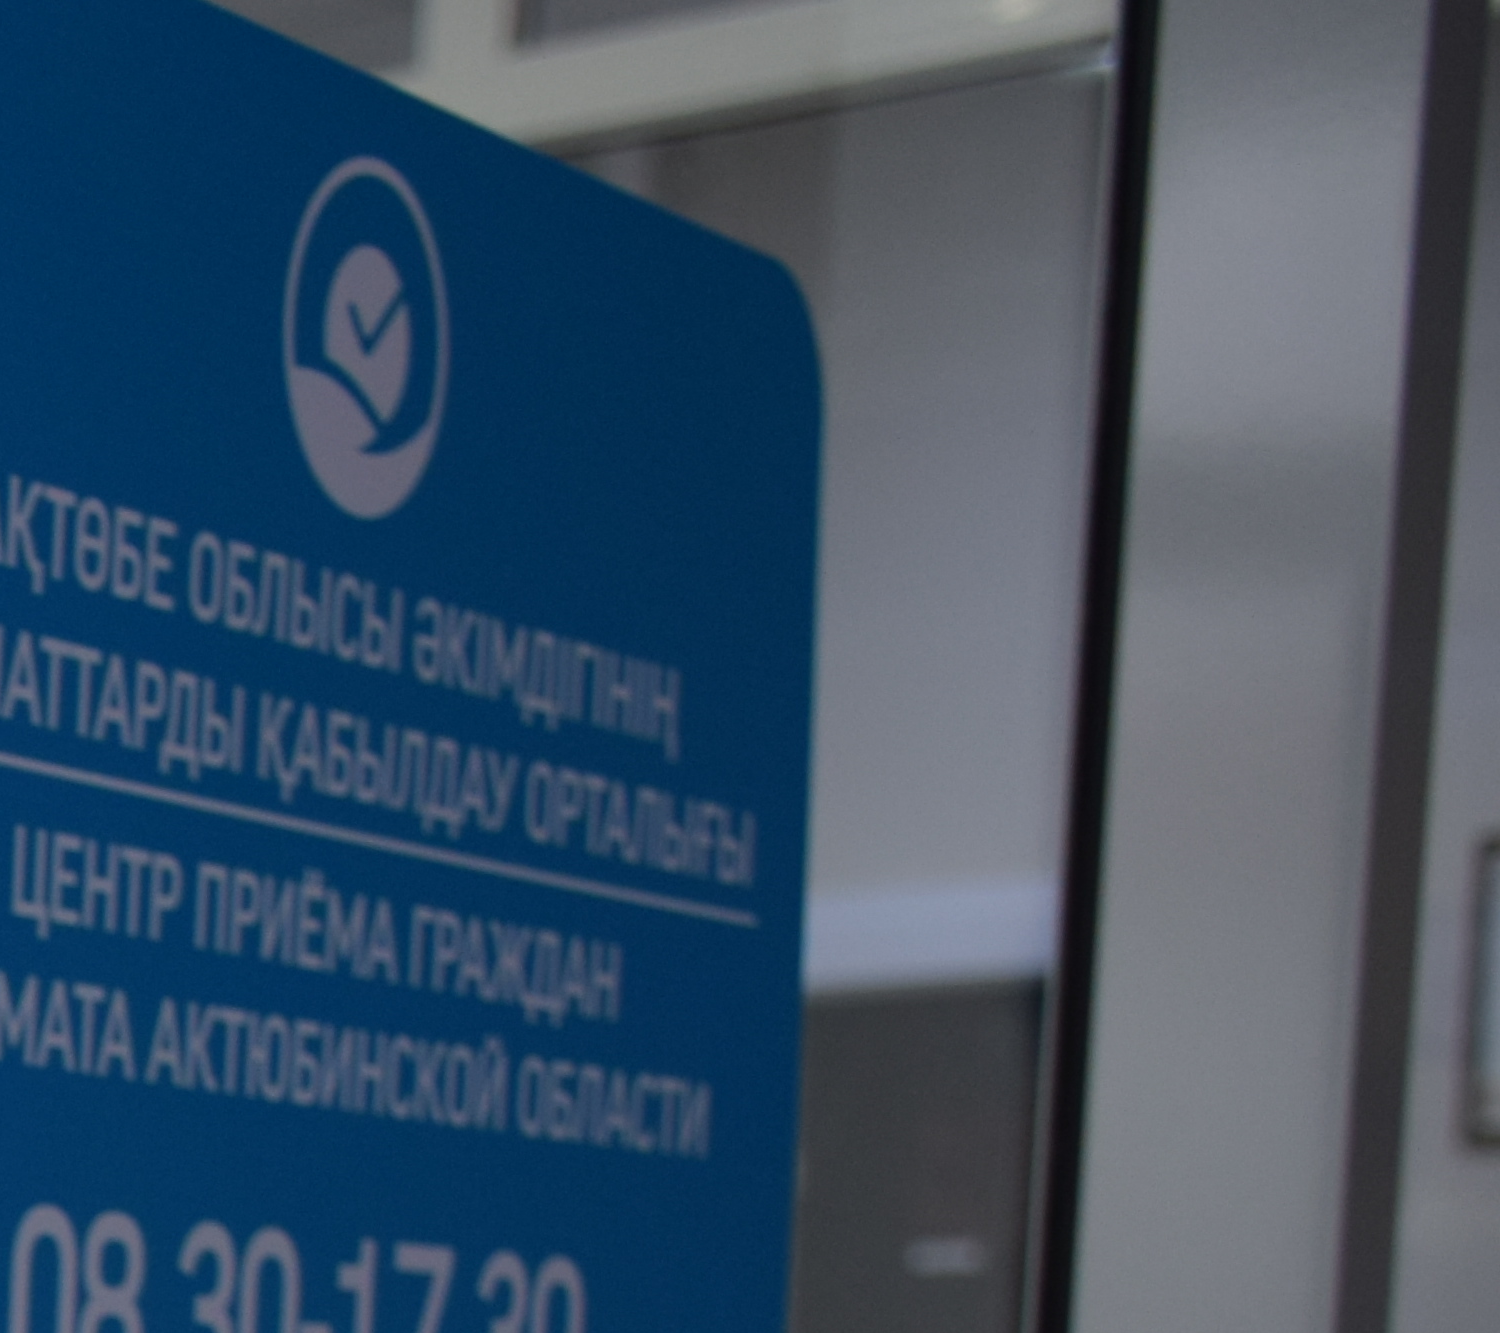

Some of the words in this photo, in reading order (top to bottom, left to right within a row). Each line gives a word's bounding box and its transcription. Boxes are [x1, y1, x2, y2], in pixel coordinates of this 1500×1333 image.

[188, 529, 405, 674] ОБЛЫСЫ
[256, 691, 520, 841] ҚАБЫЛДАУ
[525, 758, 757, 890] ОРТАЛЫҒЫ
[10, 824, 185, 939] ЦЕНТР
[194, 866, 399, 984] ПРИЁМА
[408, 905, 624, 1027] ГРАЖДАН
[144, 995, 510, 1133] АКТЮБИНСКОЙ
[517, 1053, 713, 1160] ОБЛАСТИ
